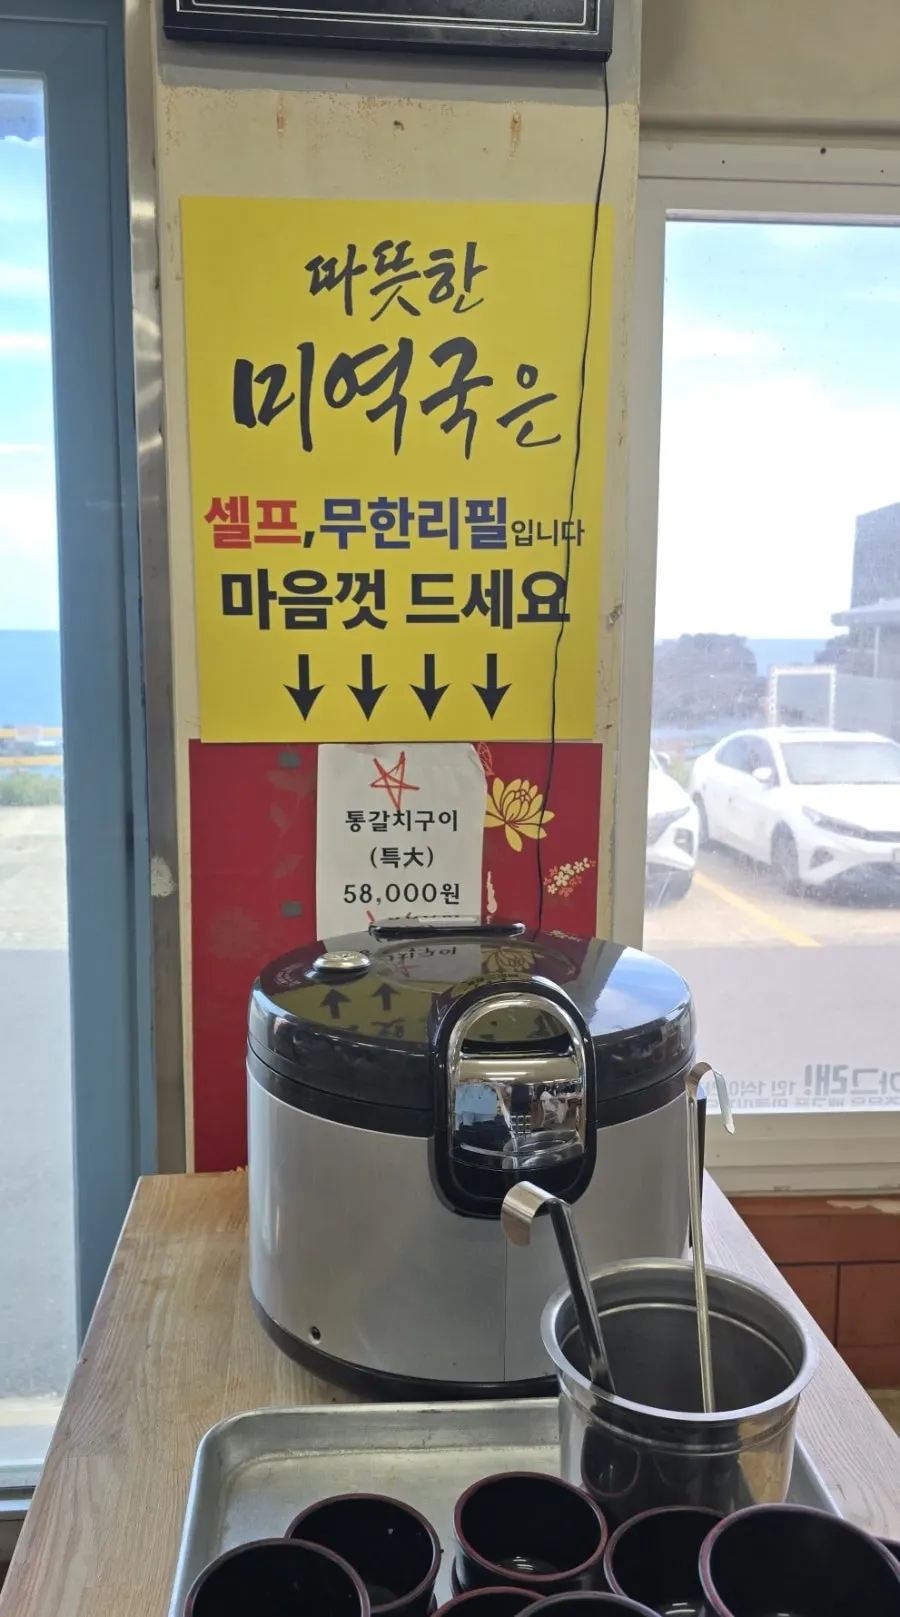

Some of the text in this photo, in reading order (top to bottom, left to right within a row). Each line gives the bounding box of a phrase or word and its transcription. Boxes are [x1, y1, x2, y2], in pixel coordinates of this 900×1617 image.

[304, 239, 488, 322] 따뜻한
[233, 336, 562, 460] 미역국은
[221, 568, 571, 630] 마음껏 드세요
[345, 809, 458, 832] 통갈치구이
[370, 846, 434, 868] (특大)
[343, 882, 460, 906] 58,000원
